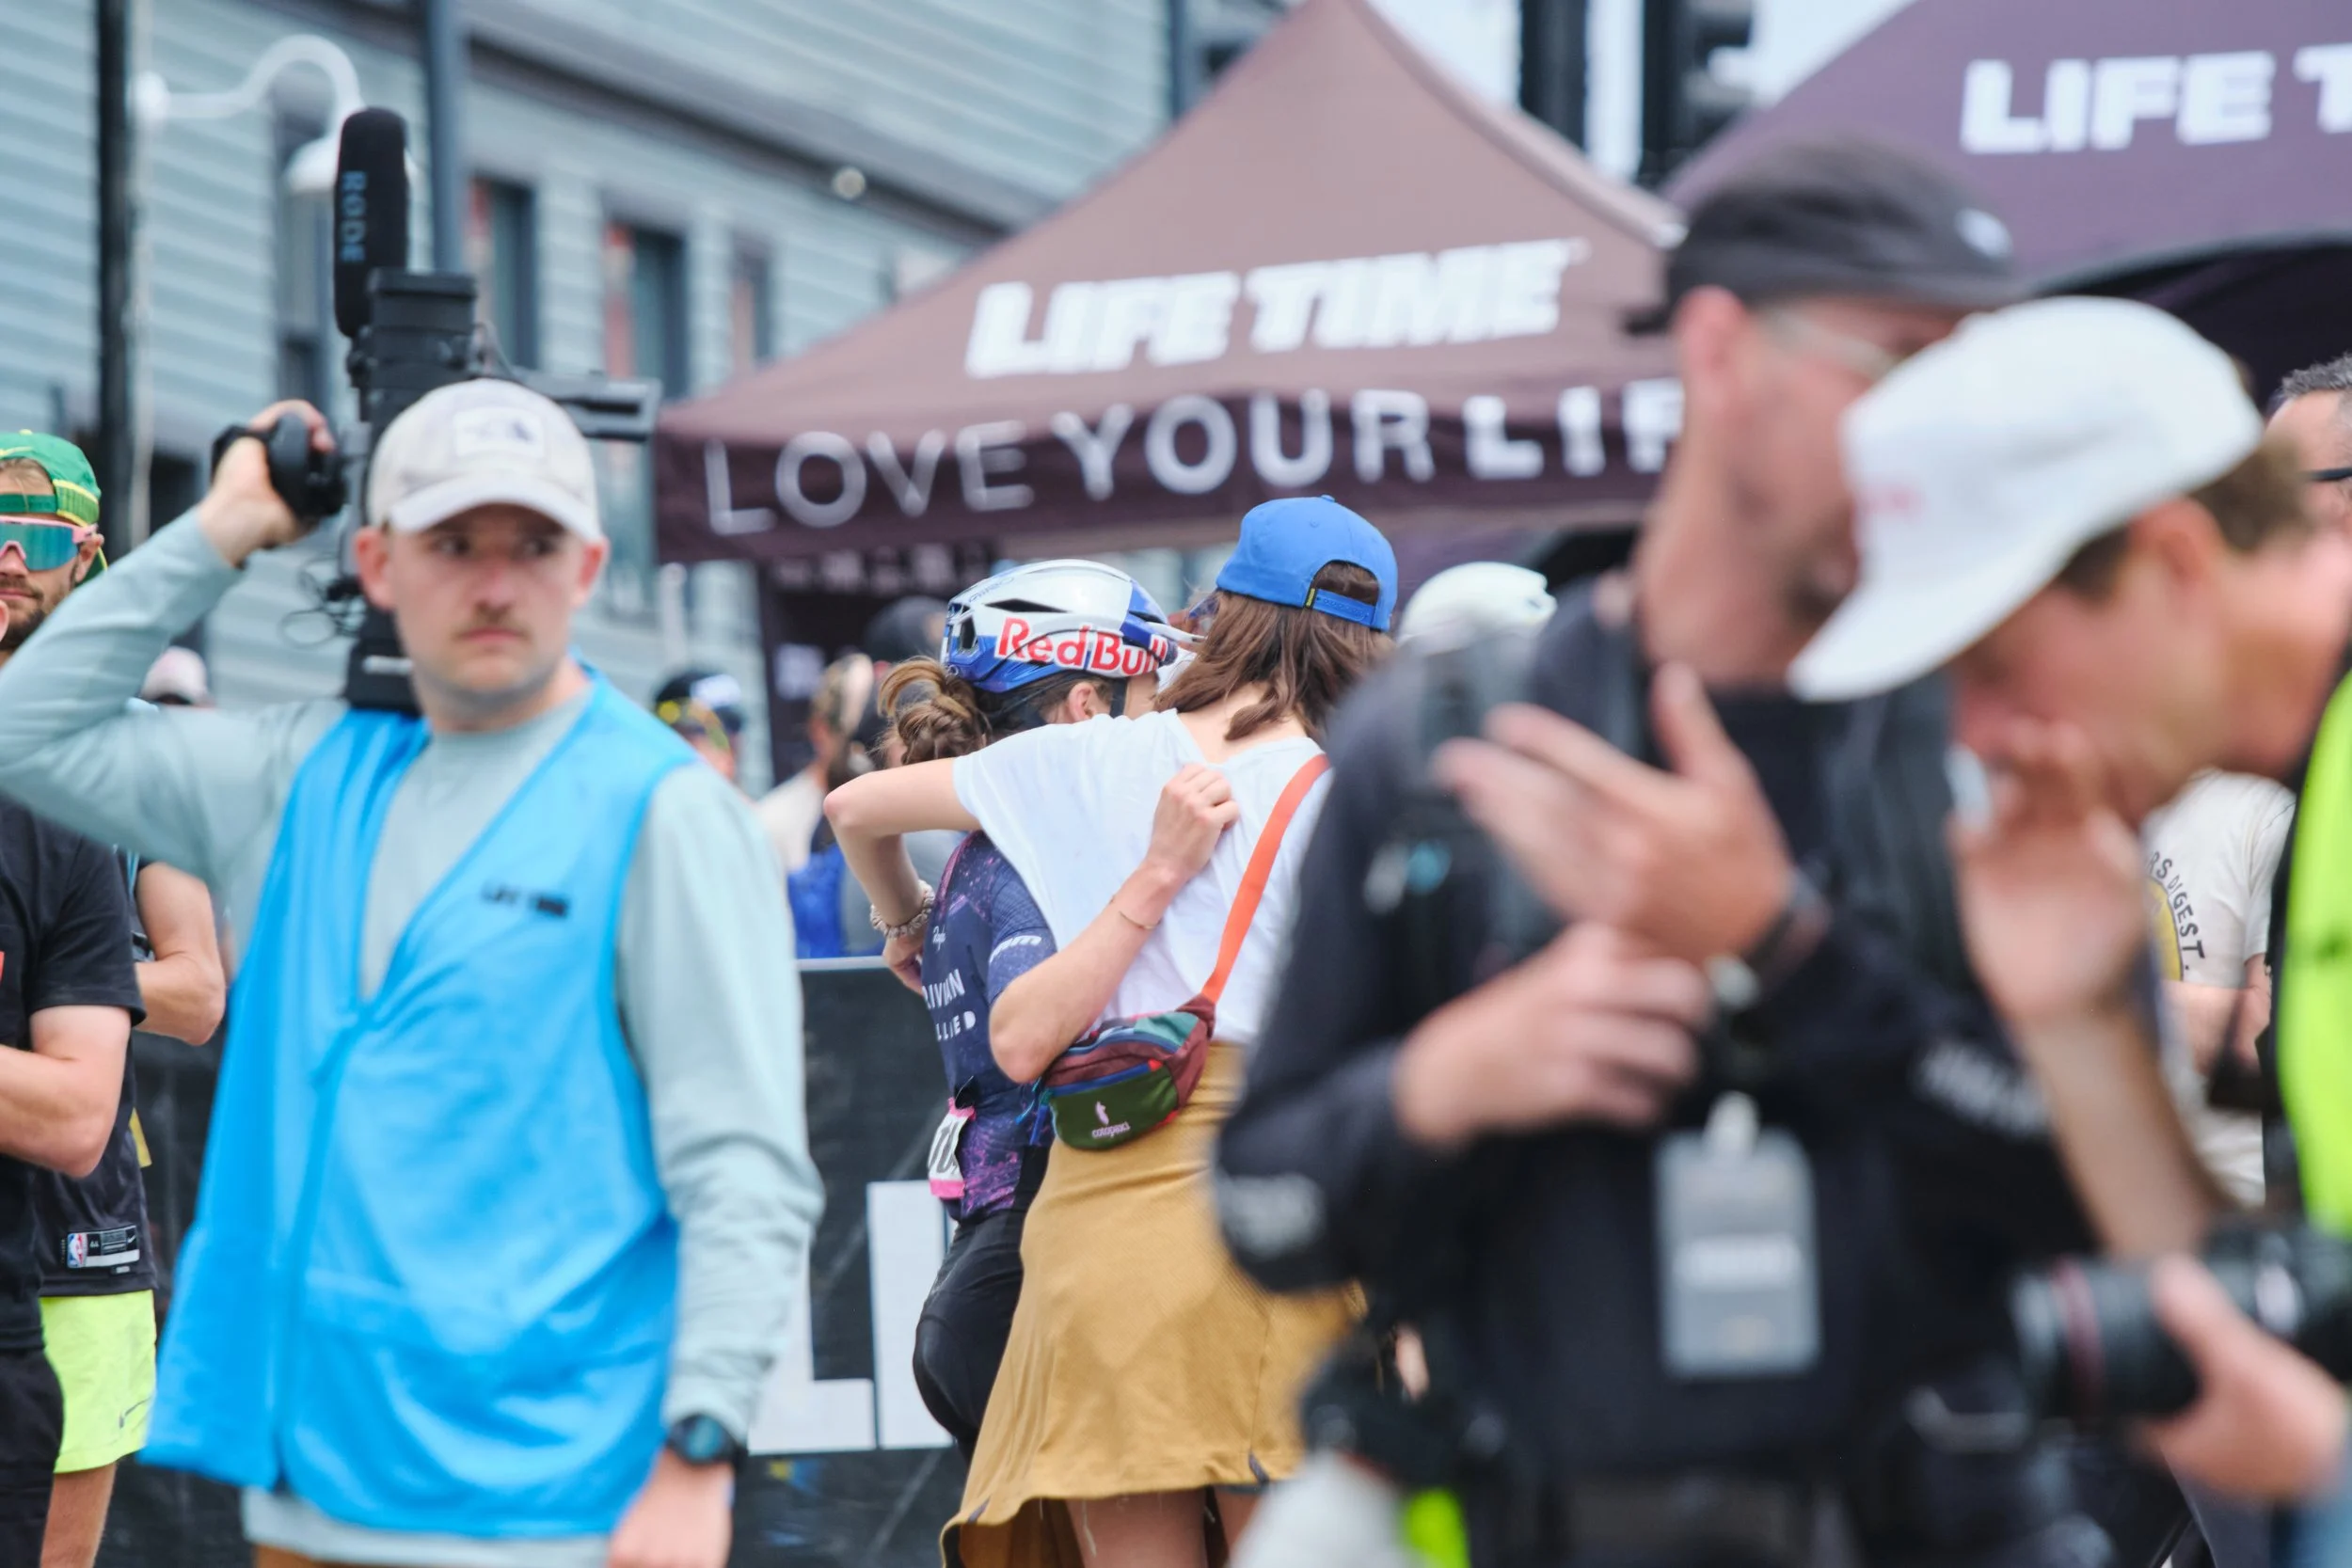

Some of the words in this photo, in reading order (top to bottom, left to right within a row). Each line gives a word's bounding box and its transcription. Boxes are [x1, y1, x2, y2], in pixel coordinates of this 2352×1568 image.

[1960, 49, 2277, 154] LIFE
[964, 270, 1241, 379] LIFE
[1245, 238, 1562, 354] TIME
[704, 420, 1034, 536] LOVE
[1050, 388, 1436, 501] YOUR
[1461, 376, 1686, 481] LIF
[997, 616, 1090, 667] Red
[1090, 628, 1168, 676] Bull
[2146, 850, 2172, 879] RS
[935, 1010, 977, 1042] LLIED
[747, 1180, 954, 1457] LI
